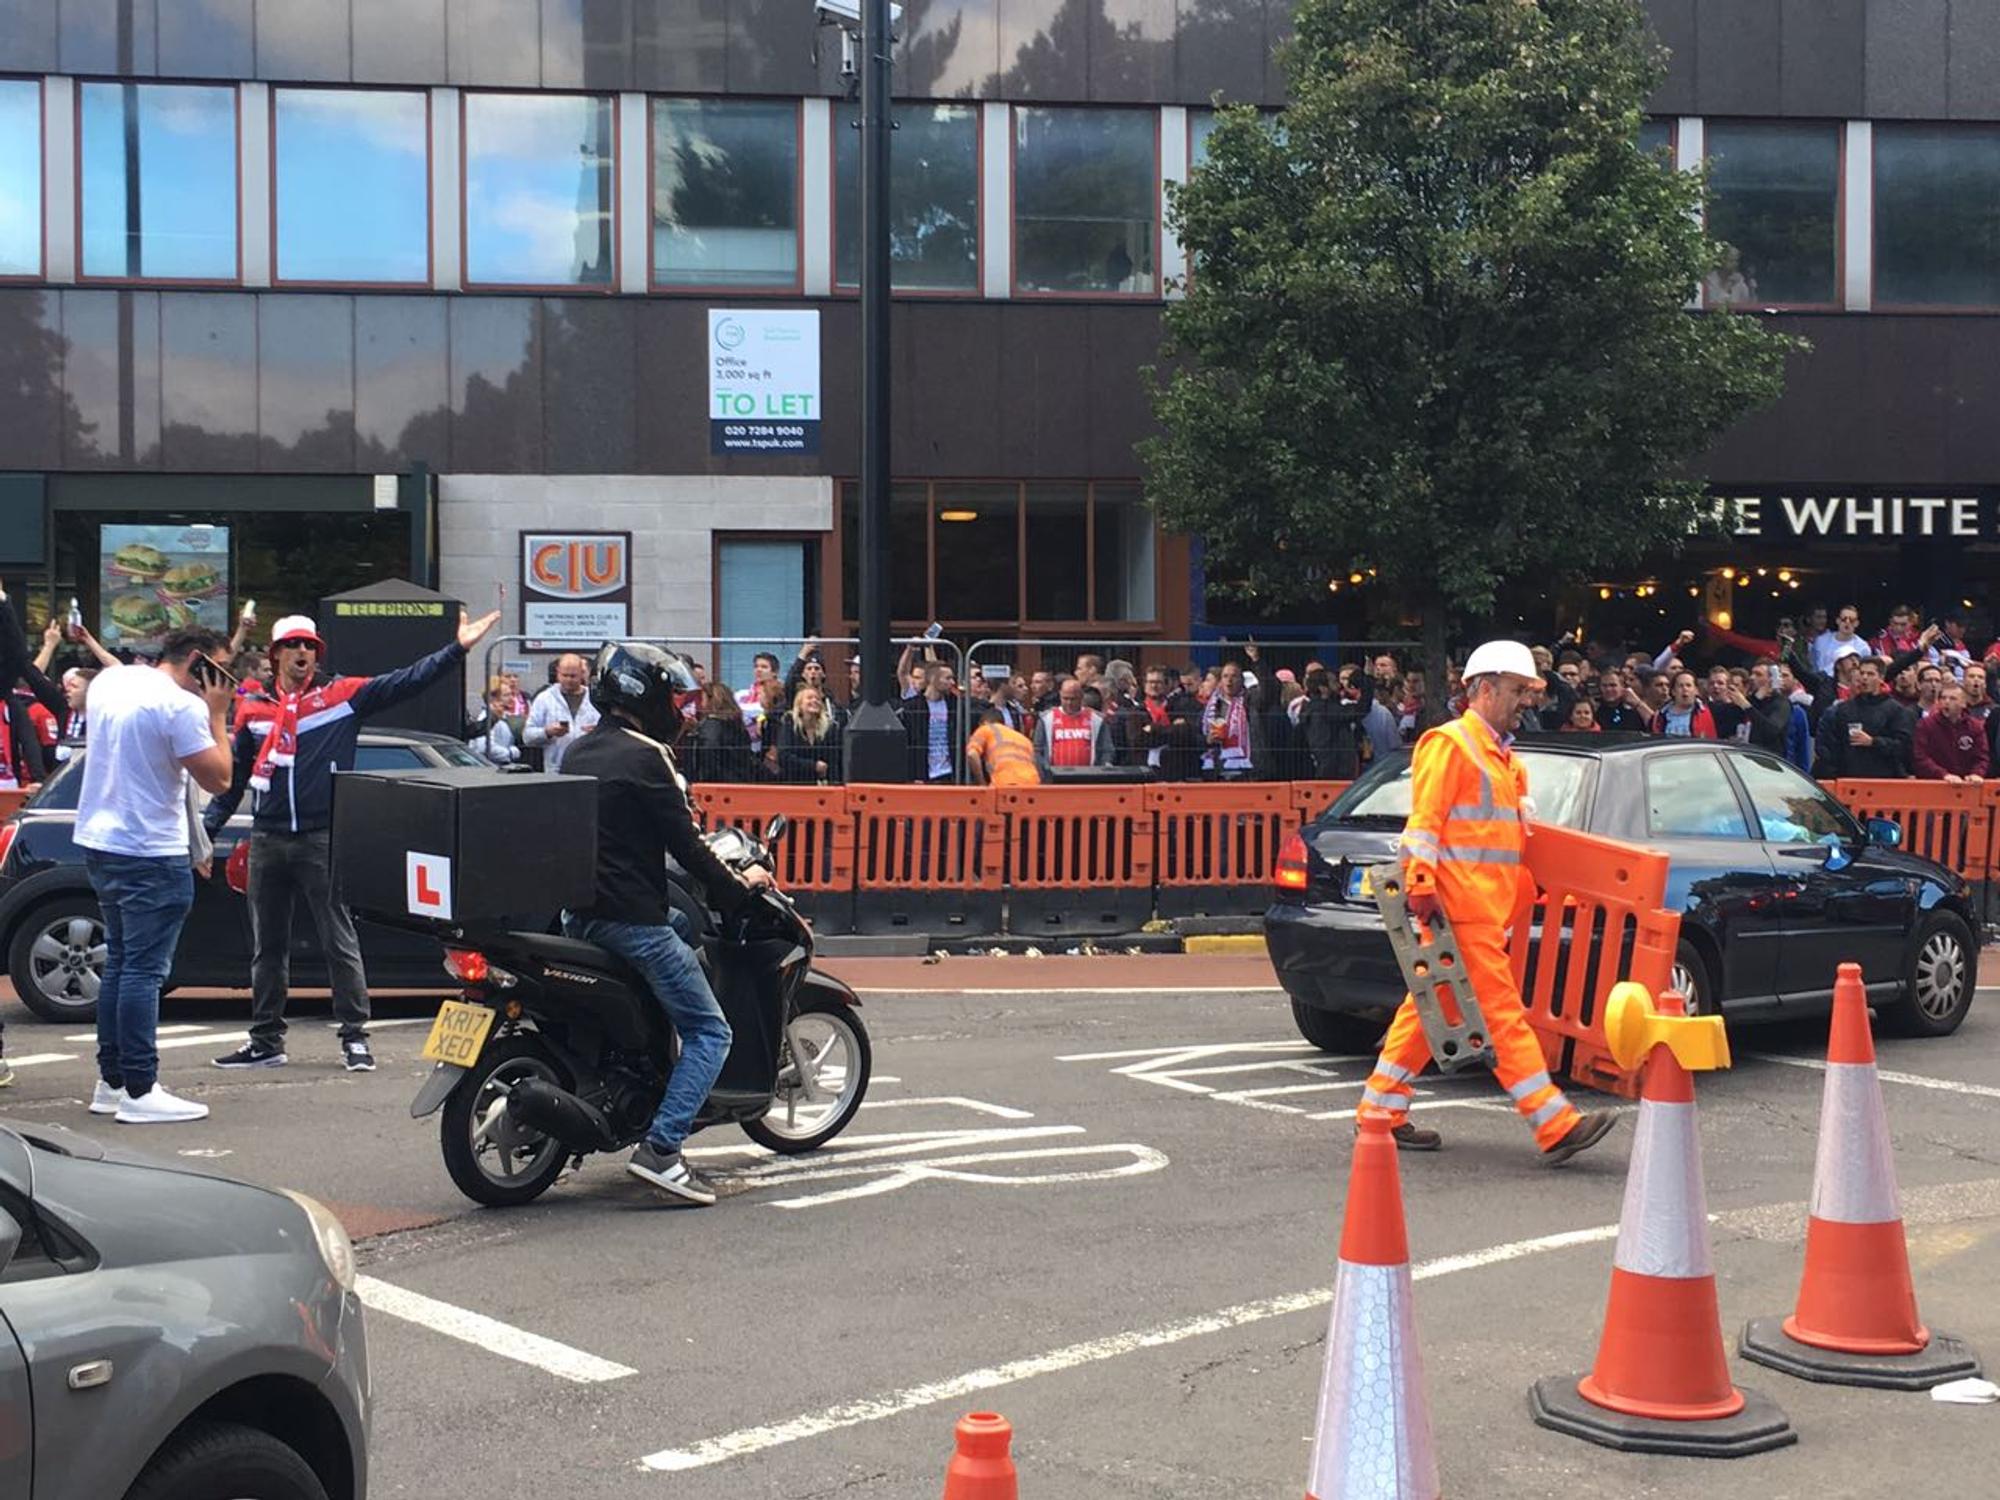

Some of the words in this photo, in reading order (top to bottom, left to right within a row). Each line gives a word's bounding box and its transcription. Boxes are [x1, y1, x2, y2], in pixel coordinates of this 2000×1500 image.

[715, 357, 747, 367] Office
[717, 394, 756, 415] TO
[766, 394, 813, 415] LET
[1782, 498, 1979, 535] WHITE
[533, 542, 620, 592] CIU
[1055, 728, 1091, 740] REWE
[417, 865, 440, 906] L
[543, 968, 598, 984] VISION
